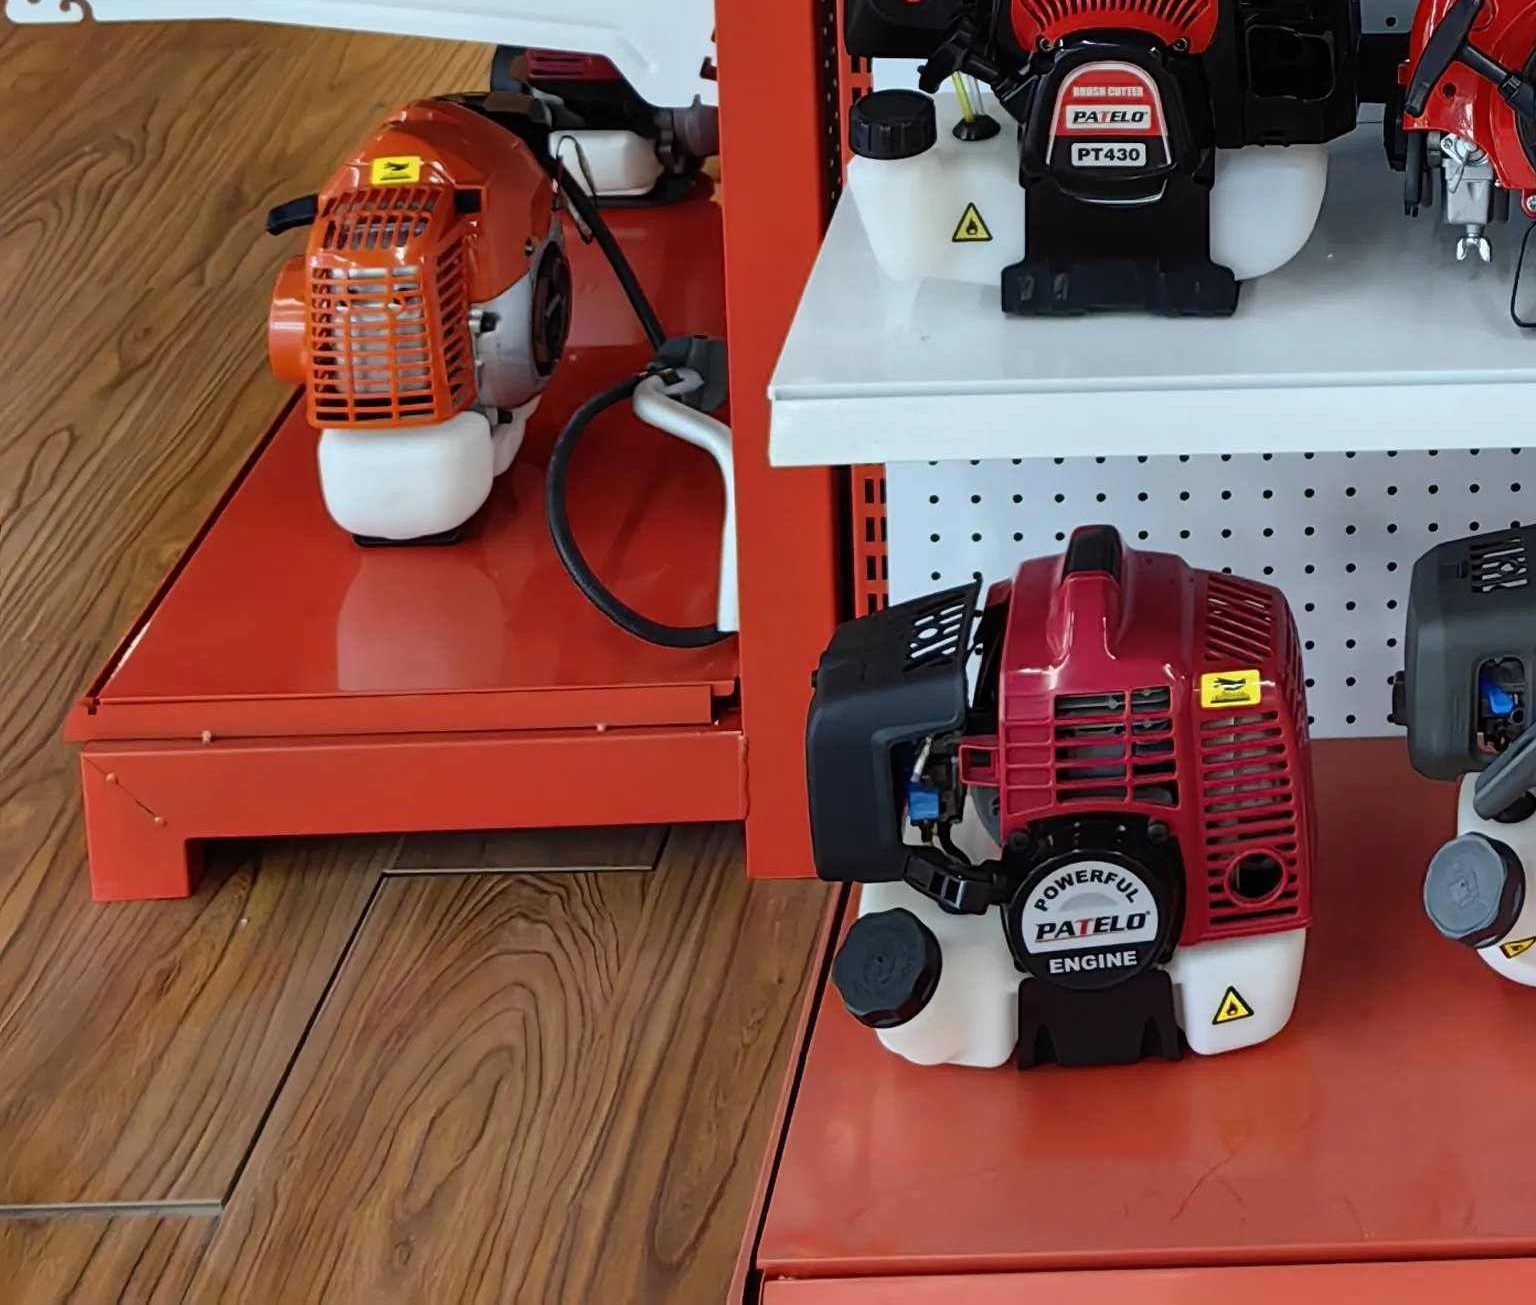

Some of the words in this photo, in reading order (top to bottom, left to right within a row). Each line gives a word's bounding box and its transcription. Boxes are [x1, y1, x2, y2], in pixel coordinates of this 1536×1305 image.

[1072, 110, 1145, 124] PATELO
[1077, 148, 1141, 161] PT430
[1034, 869, 1139, 912] POWERFUL
[1034, 912, 1147, 943] PATELO
[1049, 950, 1138, 974] ENGINE
